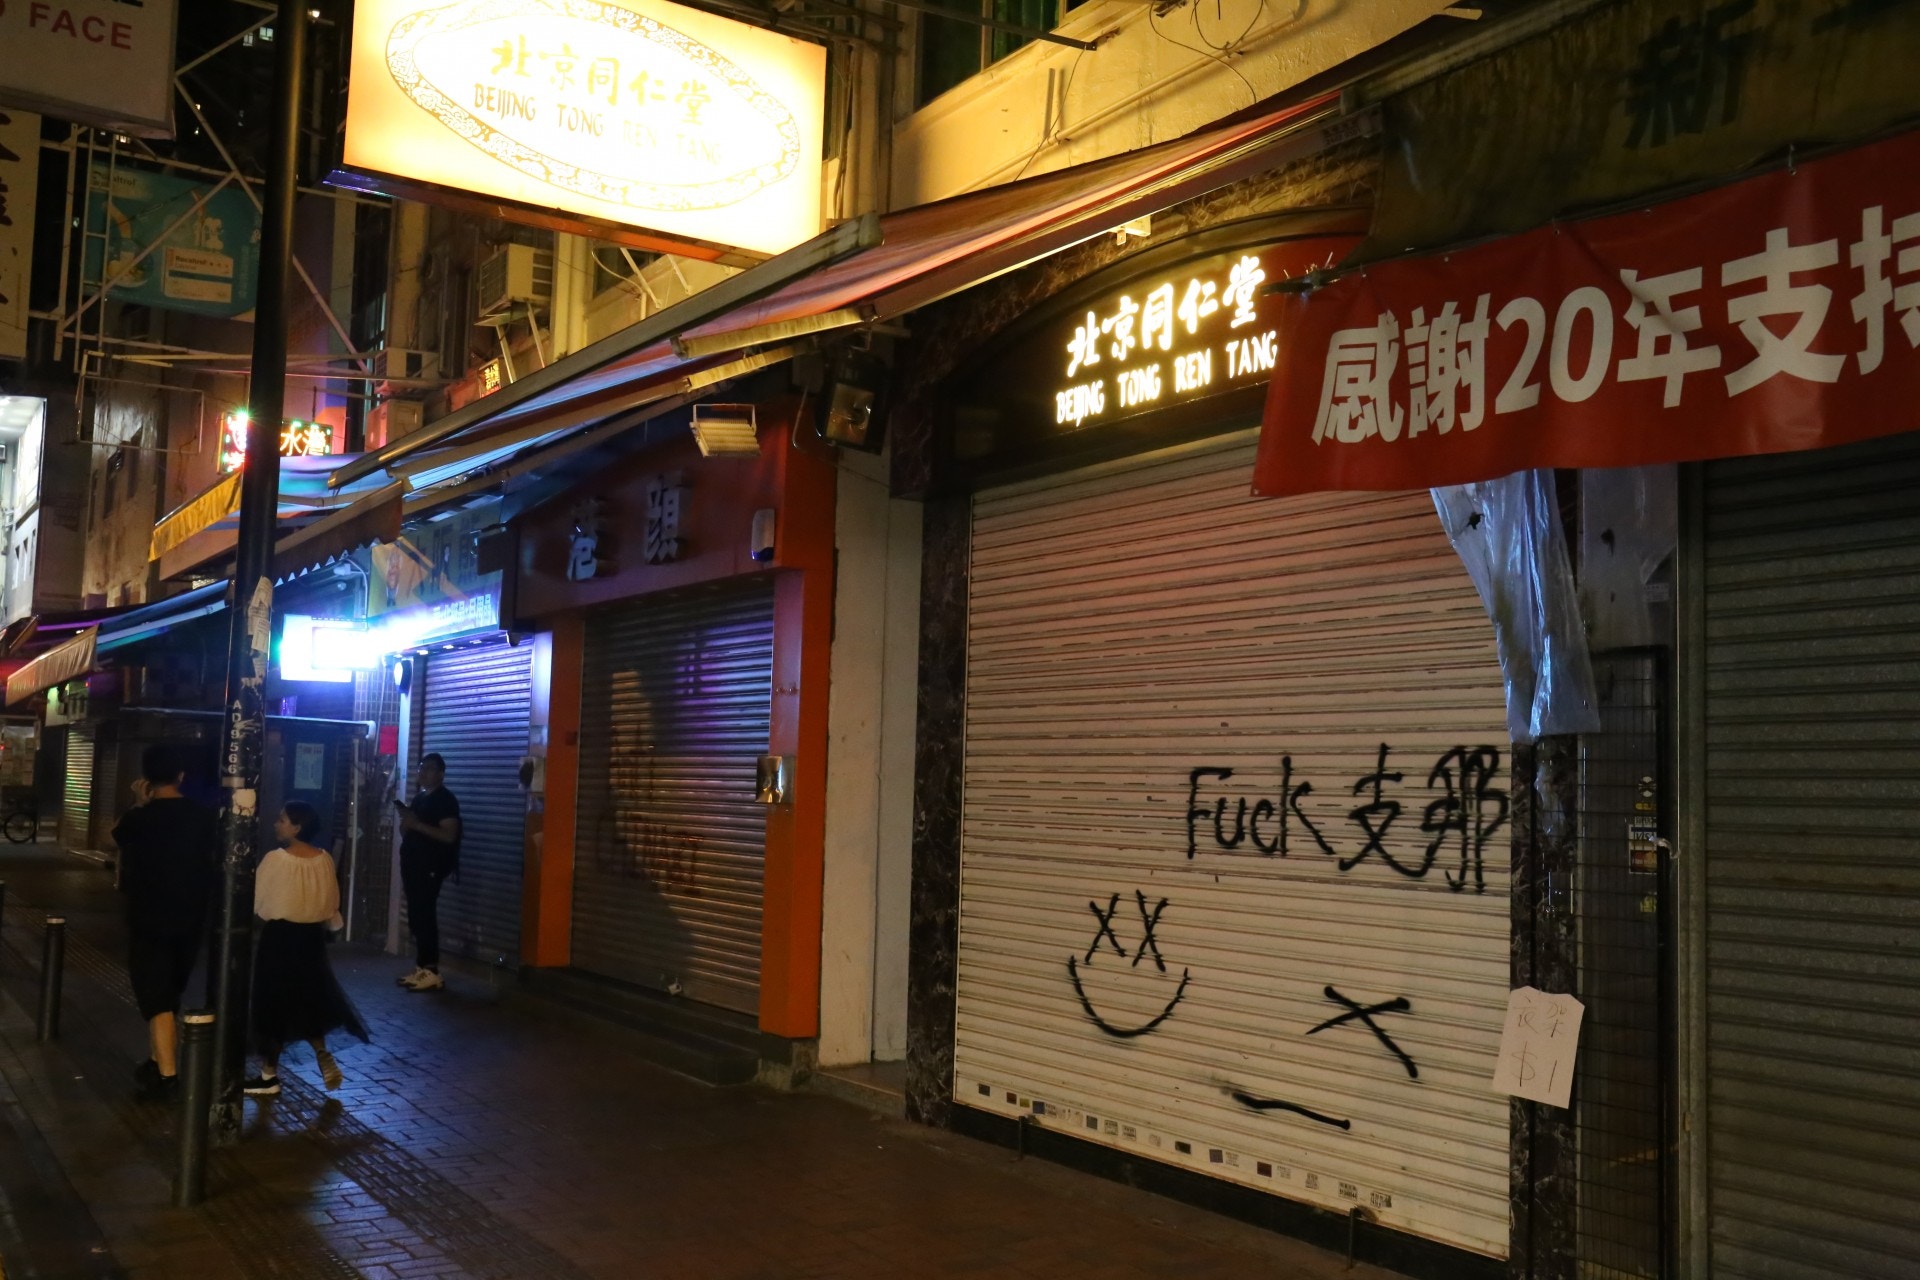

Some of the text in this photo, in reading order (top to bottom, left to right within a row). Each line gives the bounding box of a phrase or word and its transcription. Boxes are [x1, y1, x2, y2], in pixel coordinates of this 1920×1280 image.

[30, 2, 132, 50] FACE
[474, 83, 723, 166] BEIJING TONG REN TANG
[491, 34, 711, 126] 北京同仁堂
[1067, 256, 1265, 378] 北京同仁堂
[1056, 331, 1278, 427] BEIJING TONG REN TANG
[1187, 742, 1511, 893] Fuck 支那
